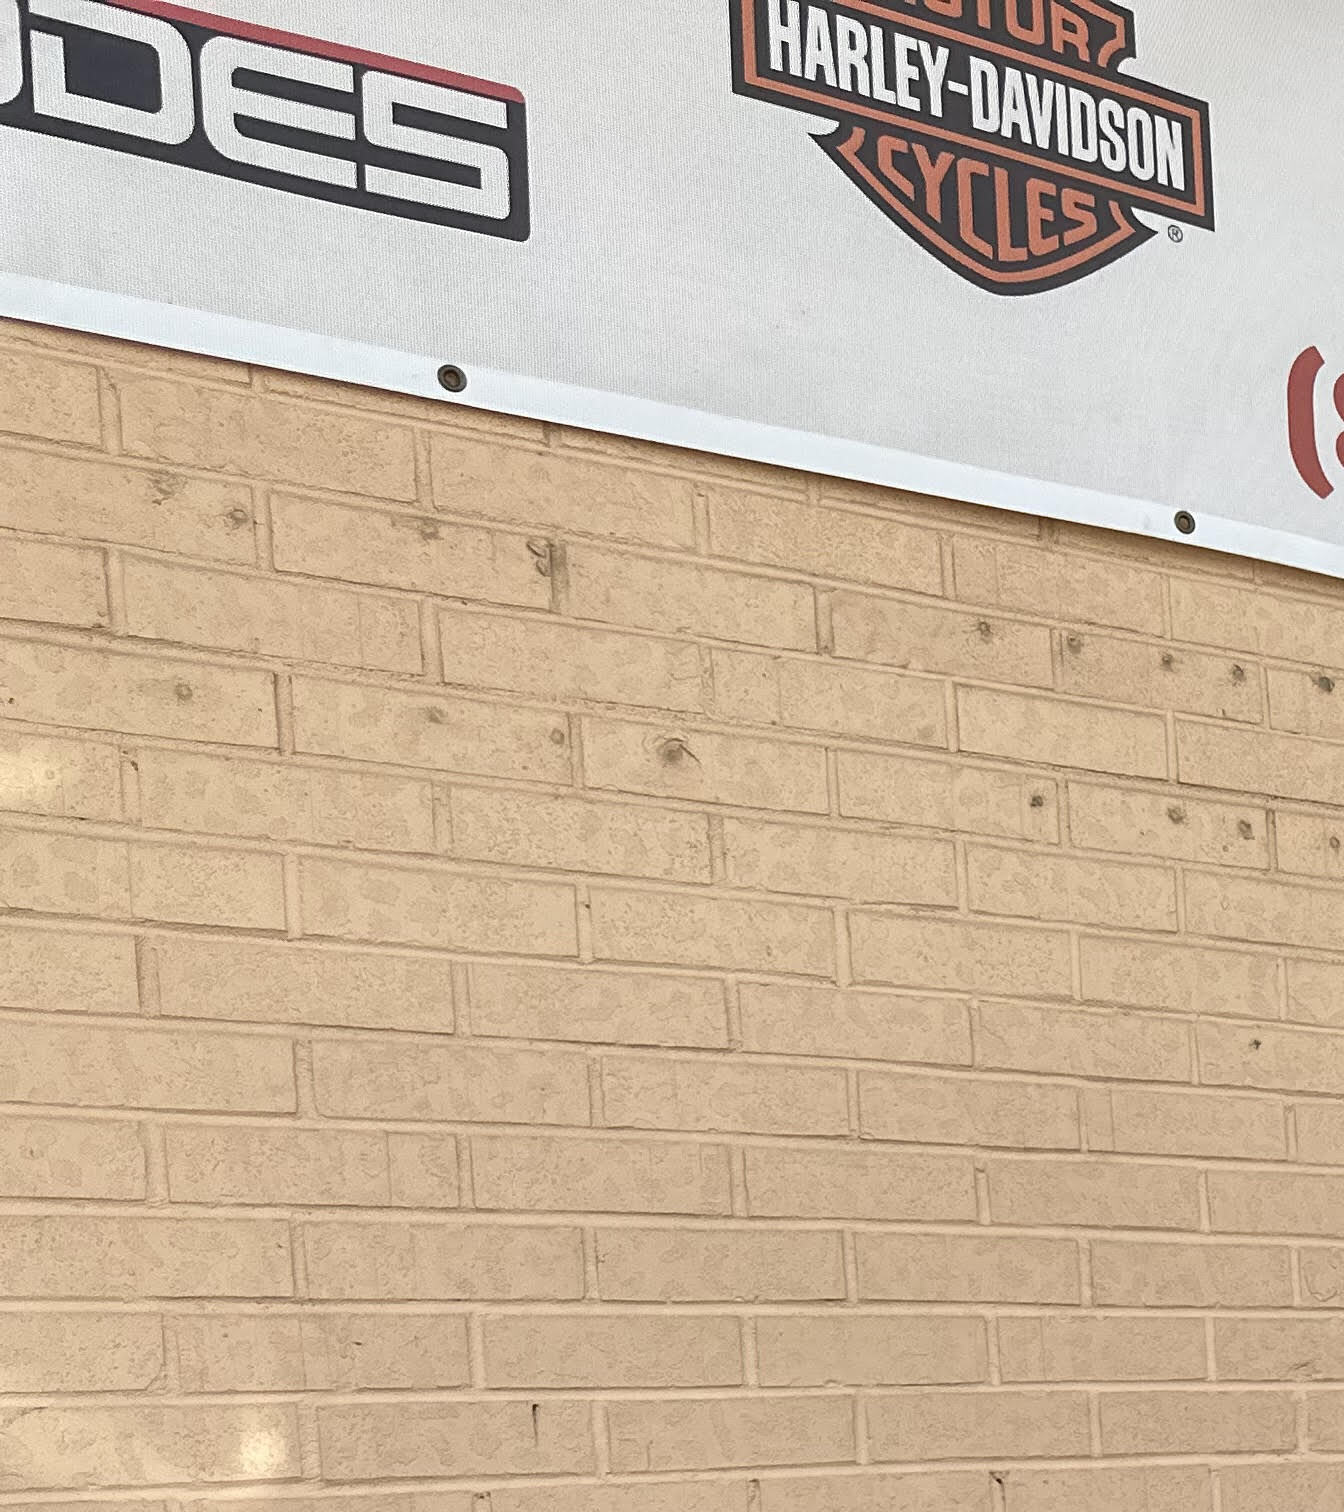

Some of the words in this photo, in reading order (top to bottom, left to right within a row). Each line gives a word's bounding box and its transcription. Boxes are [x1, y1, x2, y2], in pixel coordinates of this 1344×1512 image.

[0, 0, 511, 220] DES
[766, 0, 1186, 192] HARLEY-DAVIDSON
[877, 135, 1097, 262] CYCLES
